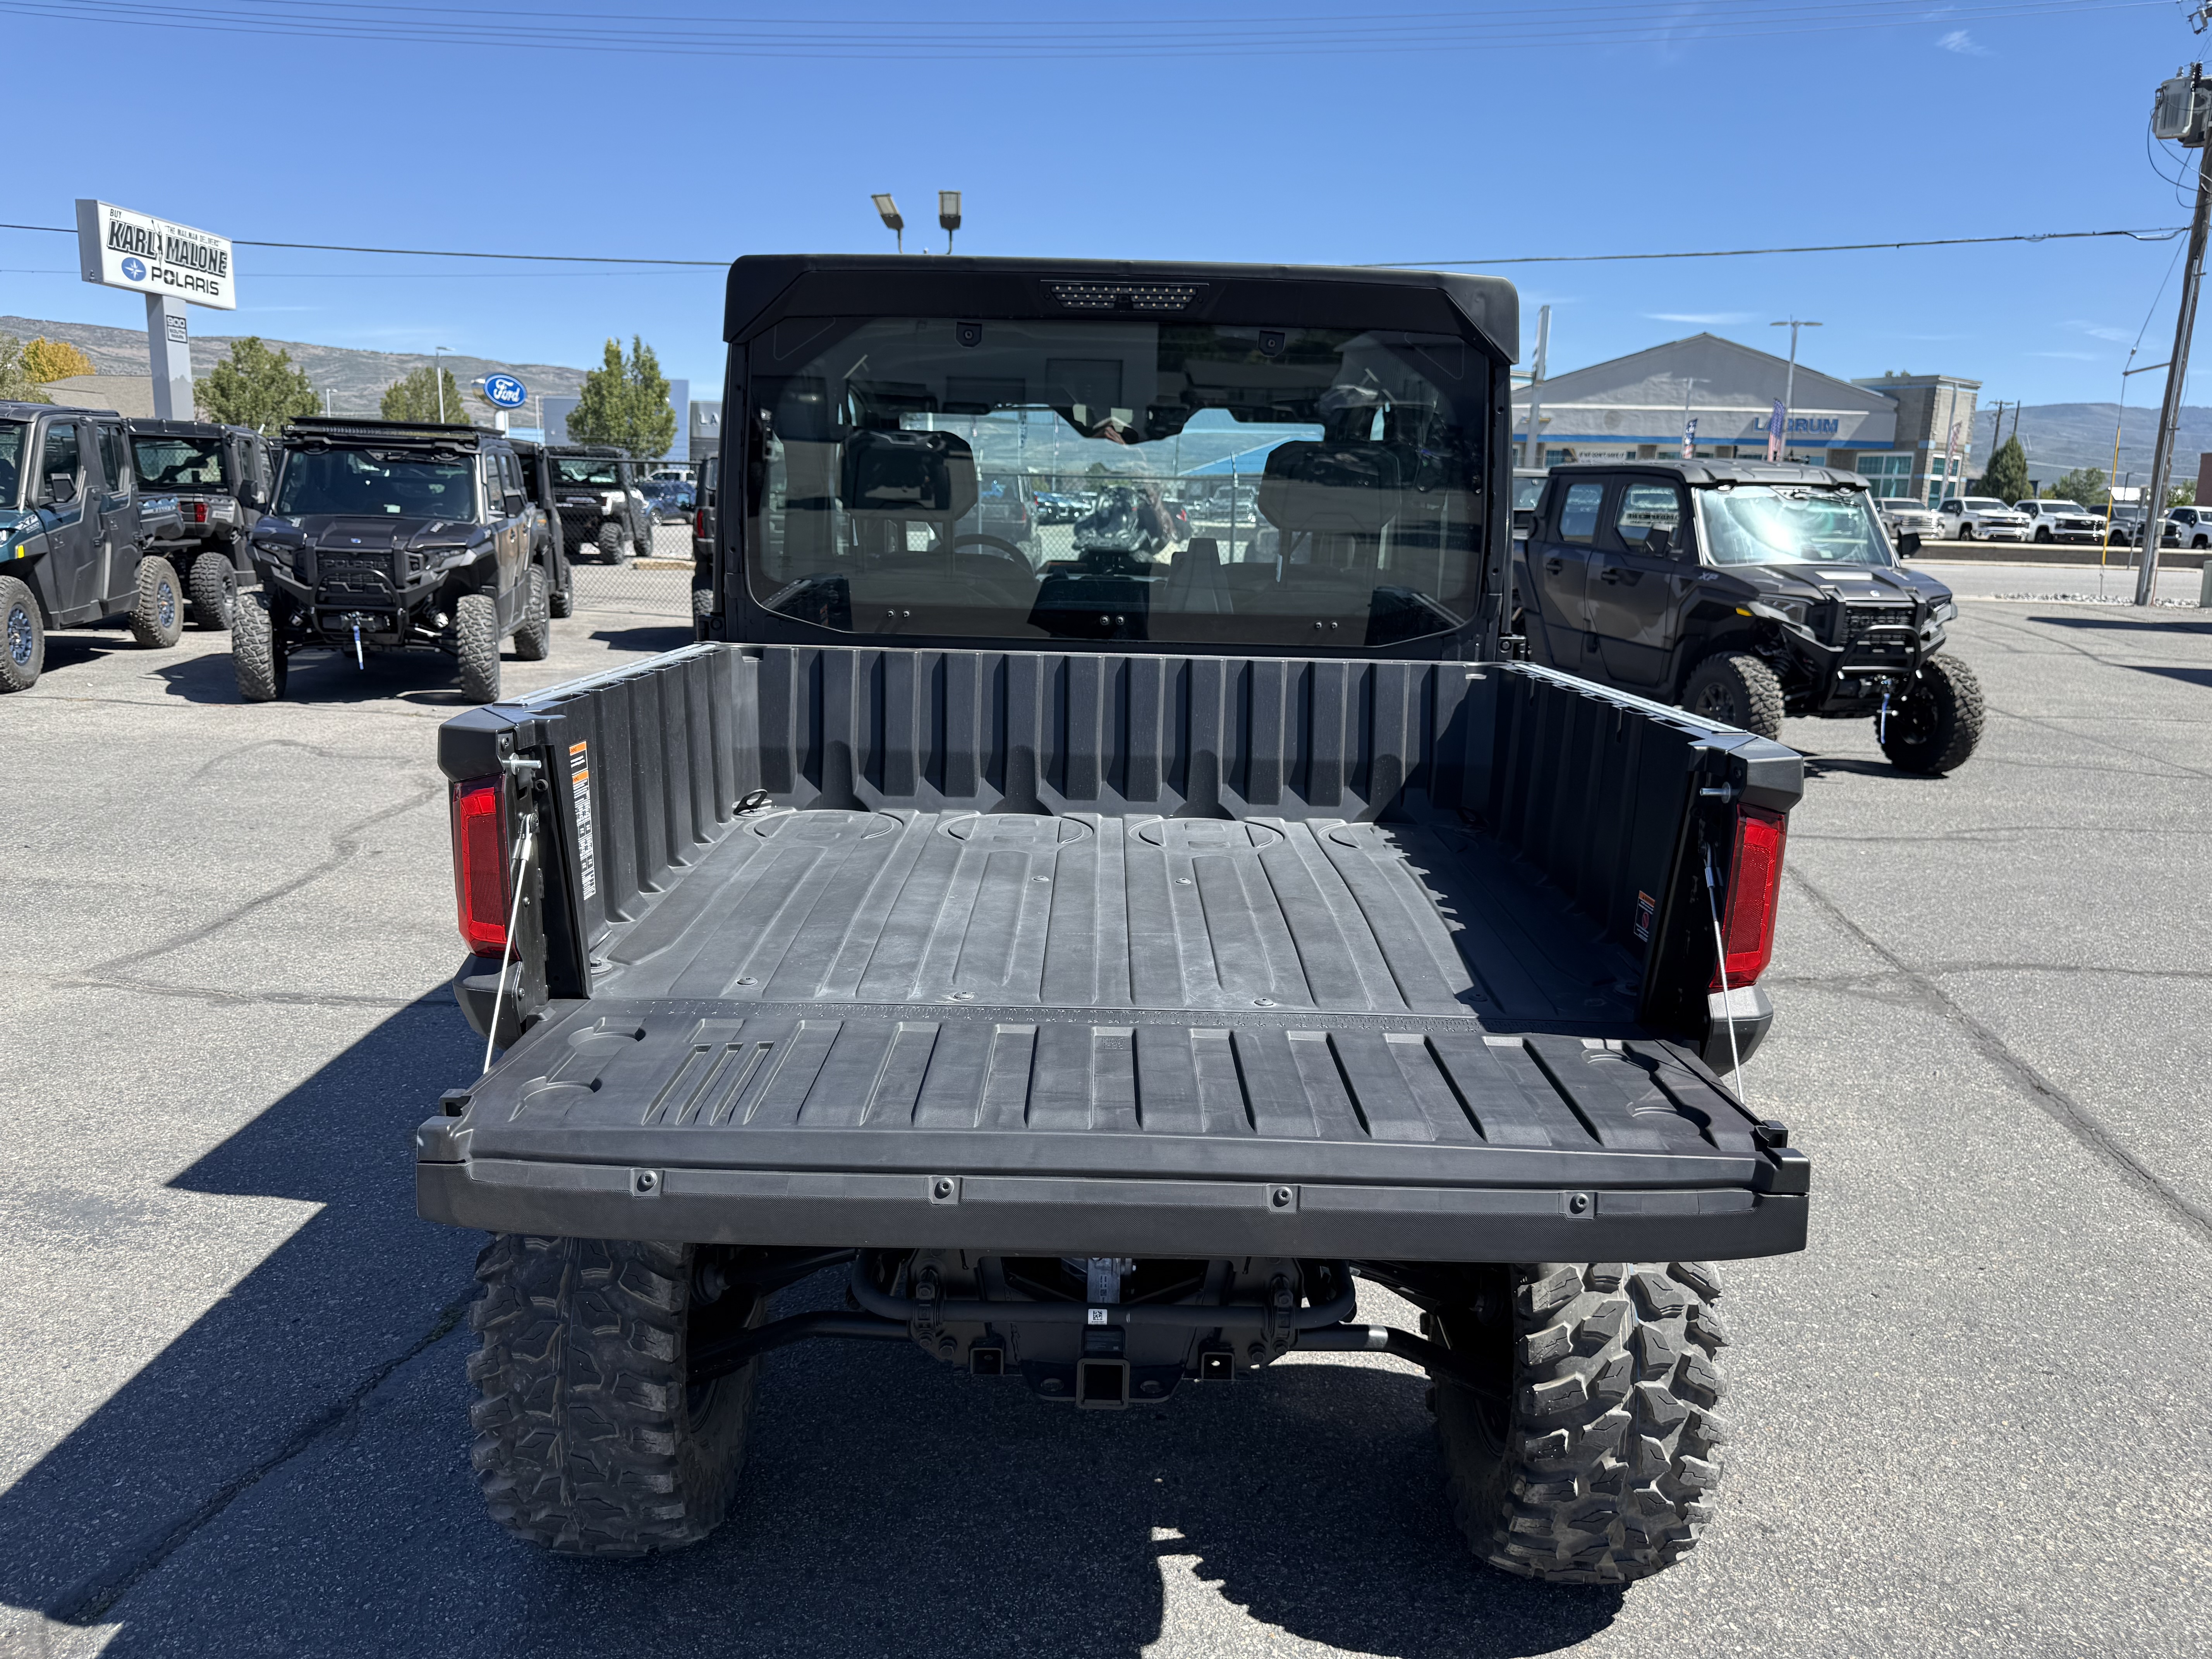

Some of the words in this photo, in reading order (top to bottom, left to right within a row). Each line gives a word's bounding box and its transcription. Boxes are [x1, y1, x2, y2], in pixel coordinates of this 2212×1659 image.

[110, 208, 122, 218] BUY
[107, 218, 157, 260] KARL
[164, 234, 228, 278] MALONE
[151, 266, 219, 296] POLARIS
[493, 378, 520, 402] Ford
[20, 515, 35, 529] XP
[1698, 572, 1719, 581] XP
